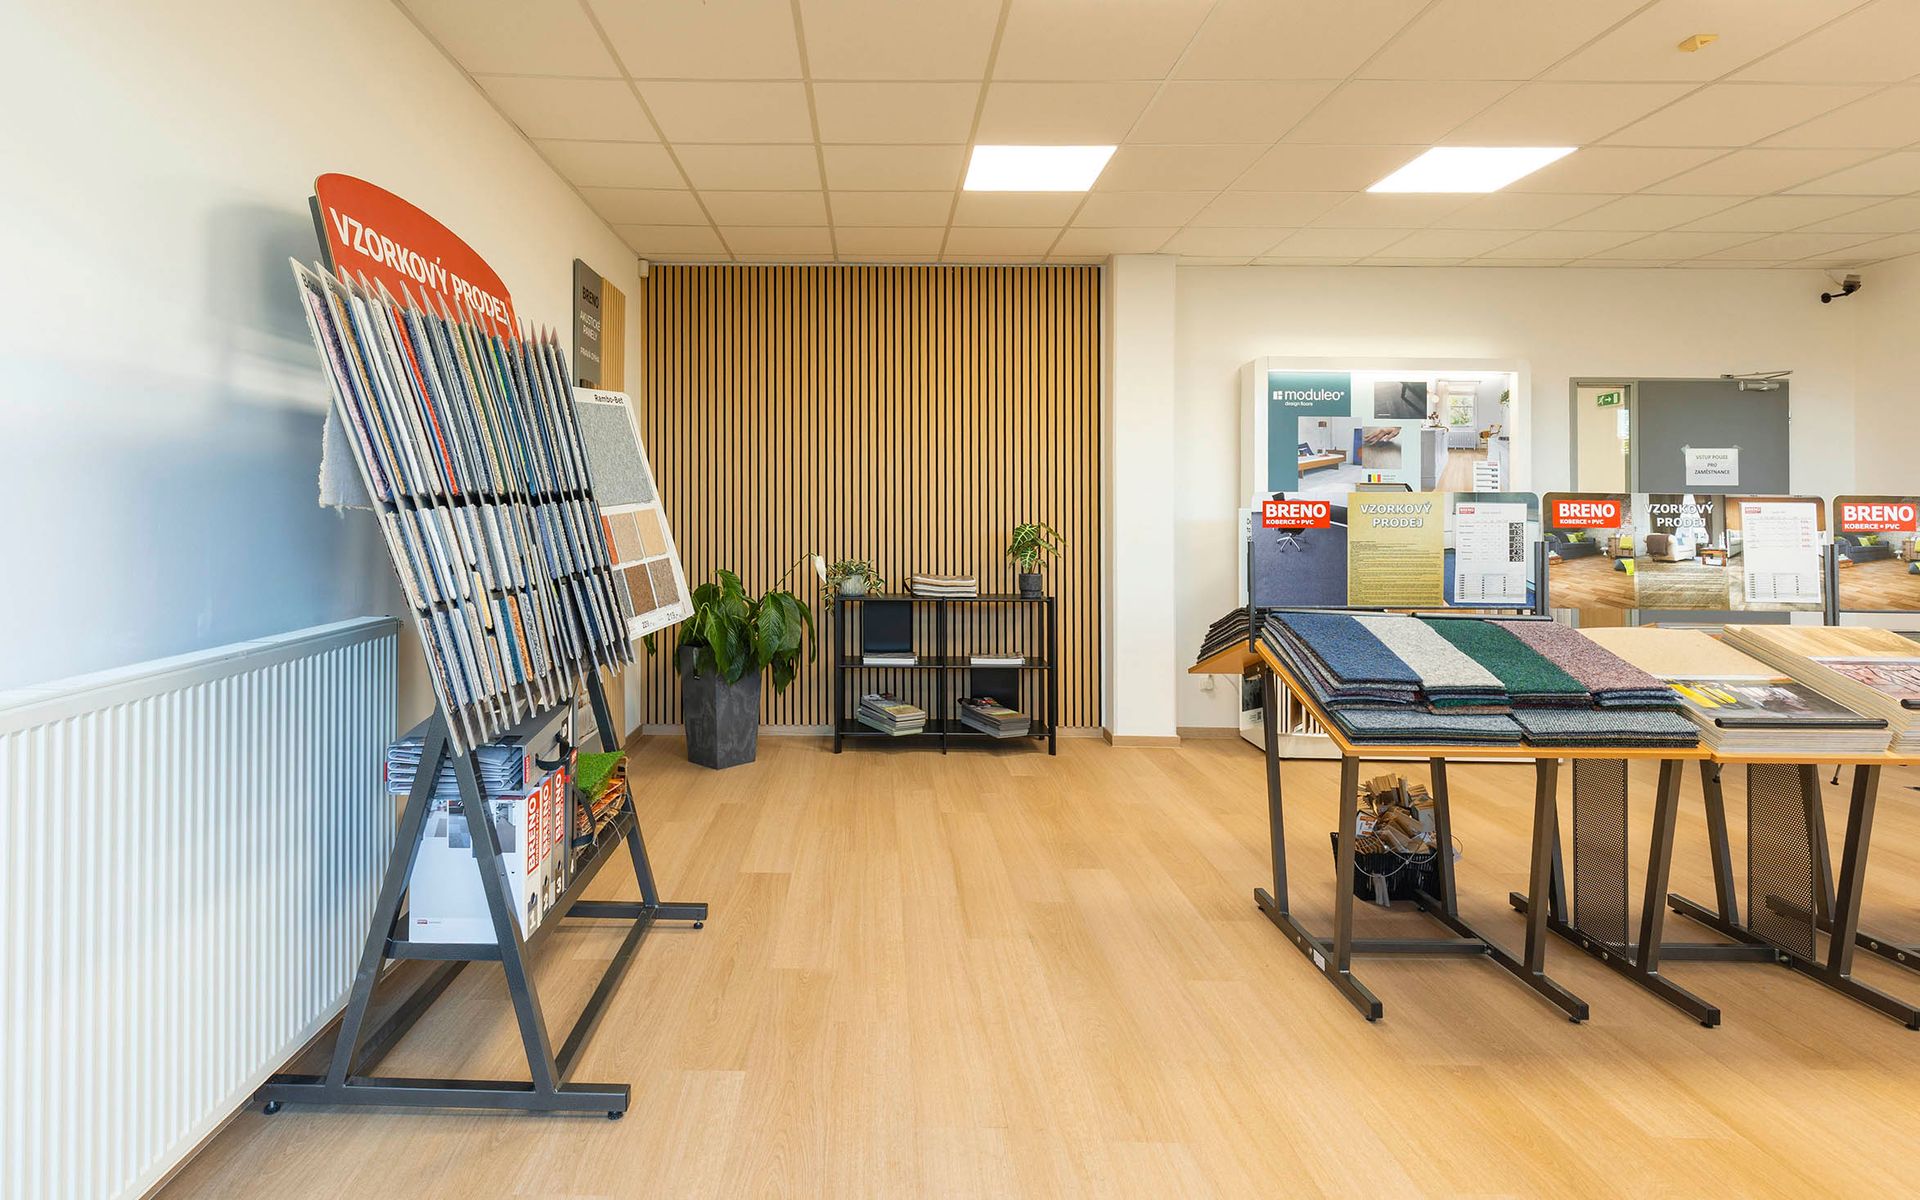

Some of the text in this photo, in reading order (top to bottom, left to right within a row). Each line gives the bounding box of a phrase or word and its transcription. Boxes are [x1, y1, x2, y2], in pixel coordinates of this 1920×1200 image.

[329, 206, 448, 295] VZORKOVÝ
[582, 286, 599, 309] BRENO
[1265, 503, 1327, 518] BRENO
[1360, 501, 1432, 515] VZORKOVÝ
[1559, 503, 1615, 518] BRENO
[1645, 501, 1714, 514] VZORKOVÝ
[1843, 505, 1914, 522] BRENO
[1372, 518, 1424, 528] PRODEJ
[1656, 517, 1706, 527] PRODEJ
[528, 796, 537, 871] BRENO
[556, 876, 562, 894] 3
[543, 892, 549, 912] 2
[529, 910, 536, 930] 1
